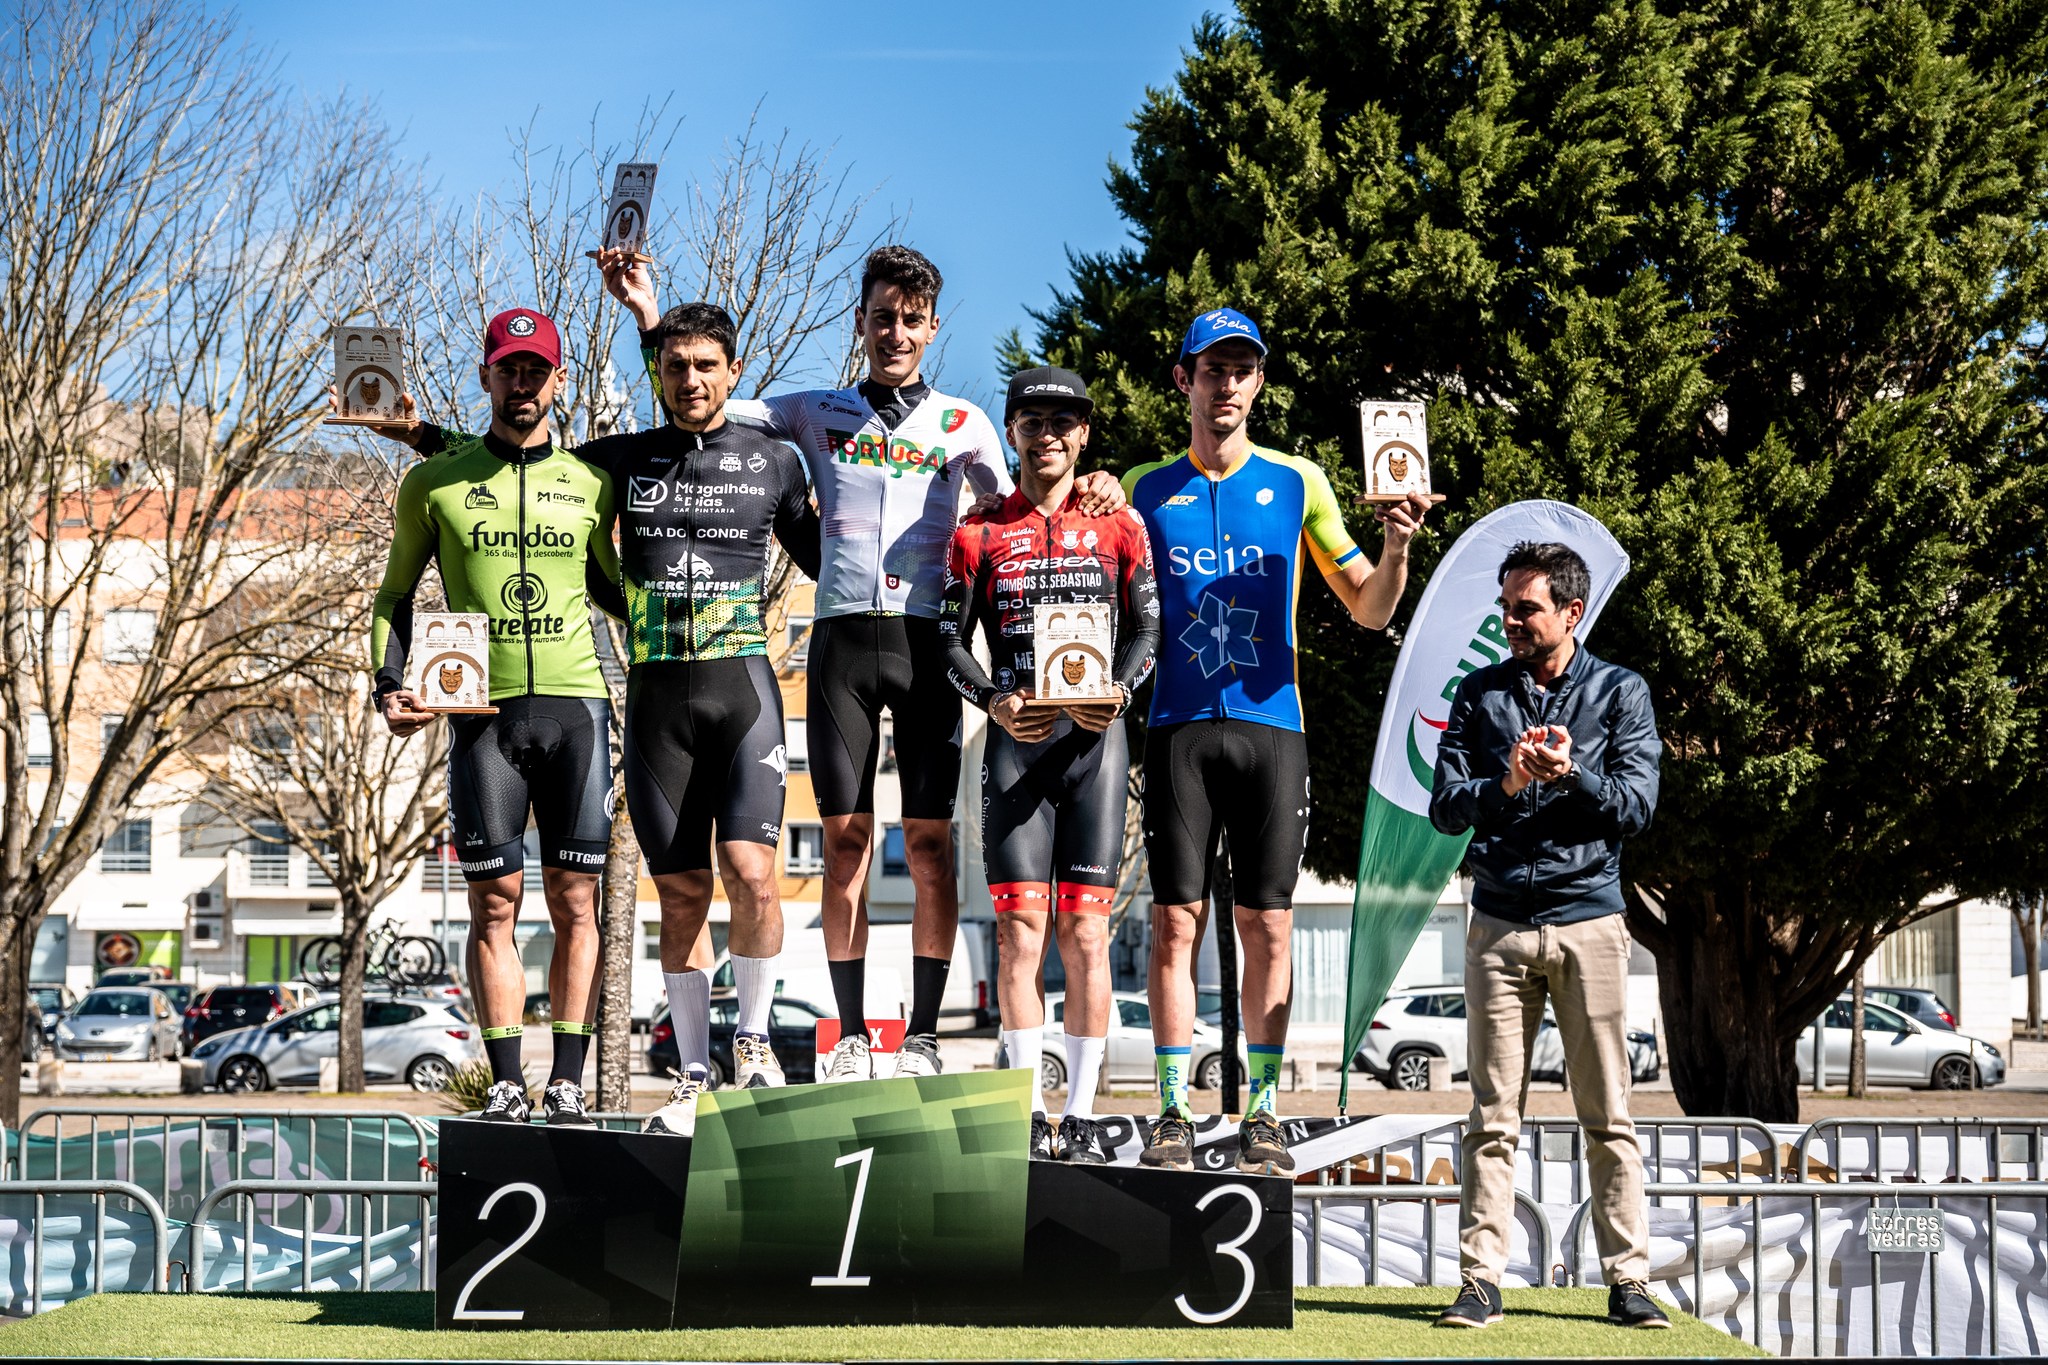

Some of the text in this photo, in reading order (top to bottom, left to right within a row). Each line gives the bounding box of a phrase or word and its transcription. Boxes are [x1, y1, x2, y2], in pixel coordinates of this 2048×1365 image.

[1024, 384, 1075, 396] ORBEA
[675, 480, 765, 497] Magalhães
[674, 494, 723, 507] & Dias
[468, 520, 575, 552] fundão
[635, 526, 749, 539] VILA DO CONDE
[484, 549, 500, 557] 365
[533, 550, 573, 558] descoberta
[1168, 534, 1269, 577] seia
[998, 556, 1101, 573] ORBEA
[997, 575, 1037, 593] BOMBOS
[1259, 1063, 1276, 1112] seia
[810, 1146, 874, 1287] 1
[1871, 1211, 1940, 1231] torres
[1871, 1228, 1942, 1248] vedras
[452, 1181, 547, 1321] 2
[1174, 1183, 1263, 1325] 3
